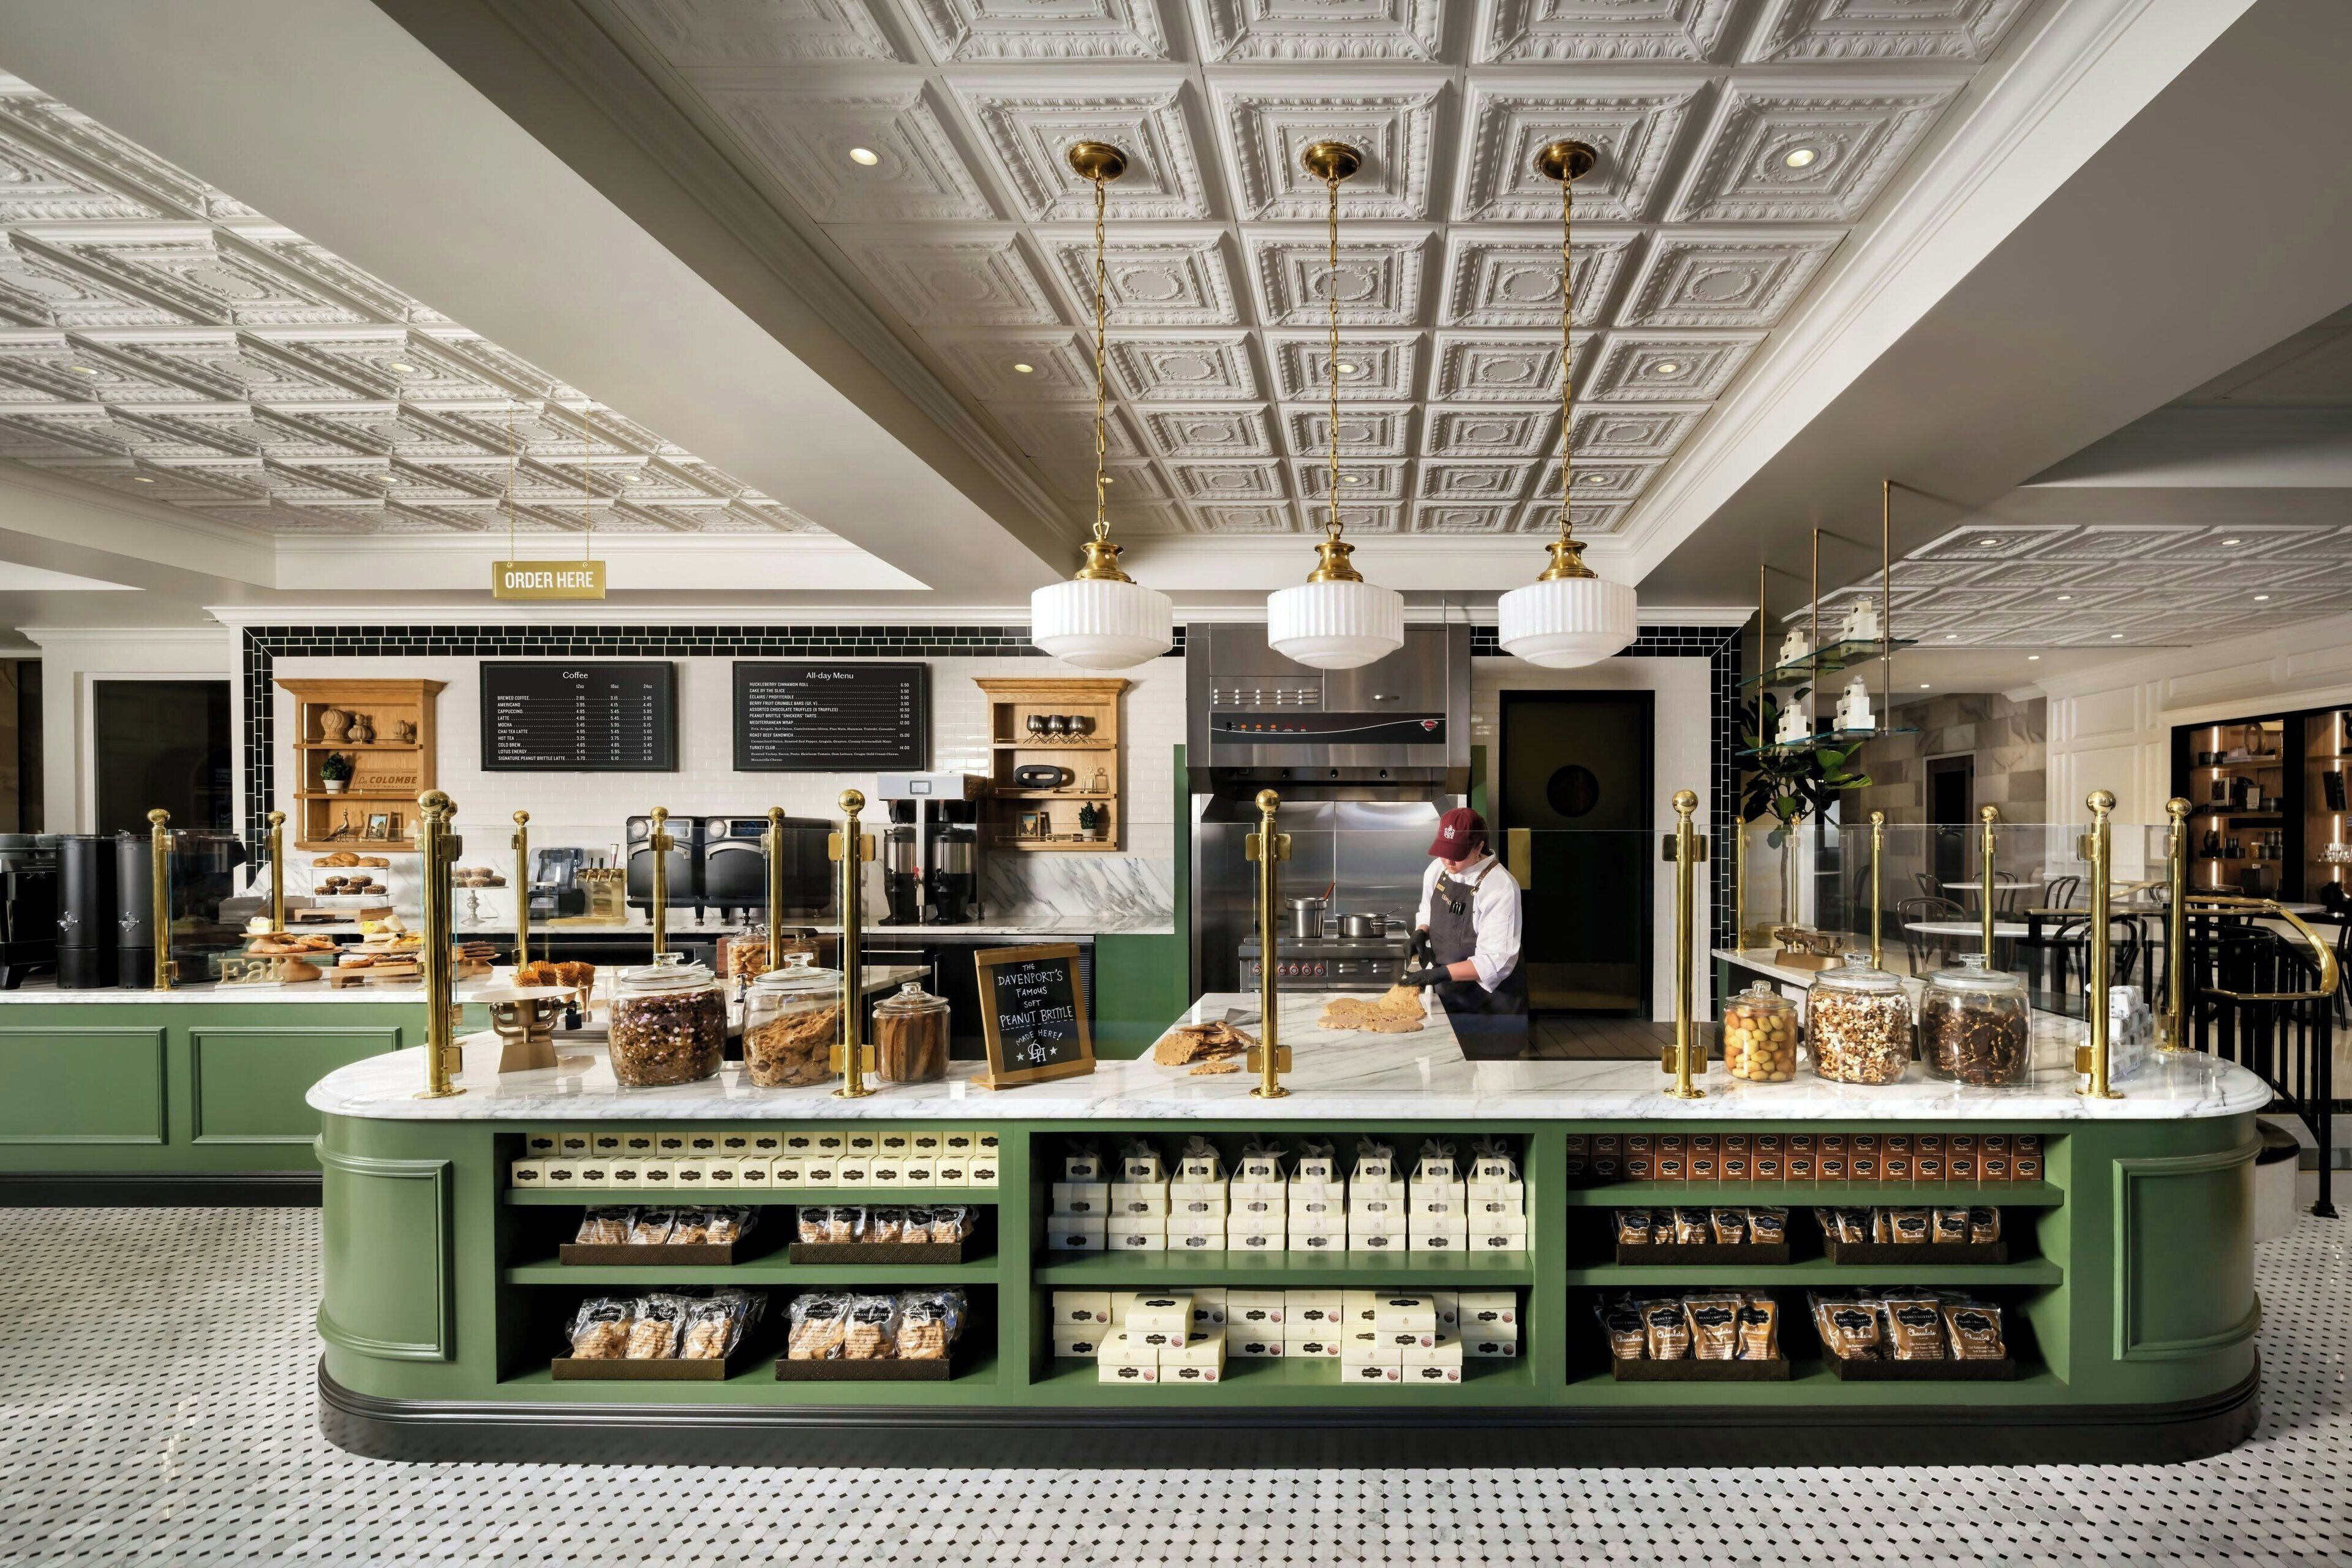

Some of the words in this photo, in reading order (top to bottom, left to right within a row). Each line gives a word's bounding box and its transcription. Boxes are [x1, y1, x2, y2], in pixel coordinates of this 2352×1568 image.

[505, 571, 553, 588] ORDER
[557, 571, 594, 587] HERE
[806, 672, 832, 680] All-day
[217, 957, 285, 984] Eat
[998, 969, 1063, 986] DAVENPORT'S
[1016, 987, 1047, 998] FAMOUS
[1000, 1011, 1036, 1027] PEANUT
[1040, 1006, 1073, 1022] BRITTLE
[1016, 1031, 1034, 1046] MADE
[1038, 1029, 1062, 1041] HERE!
